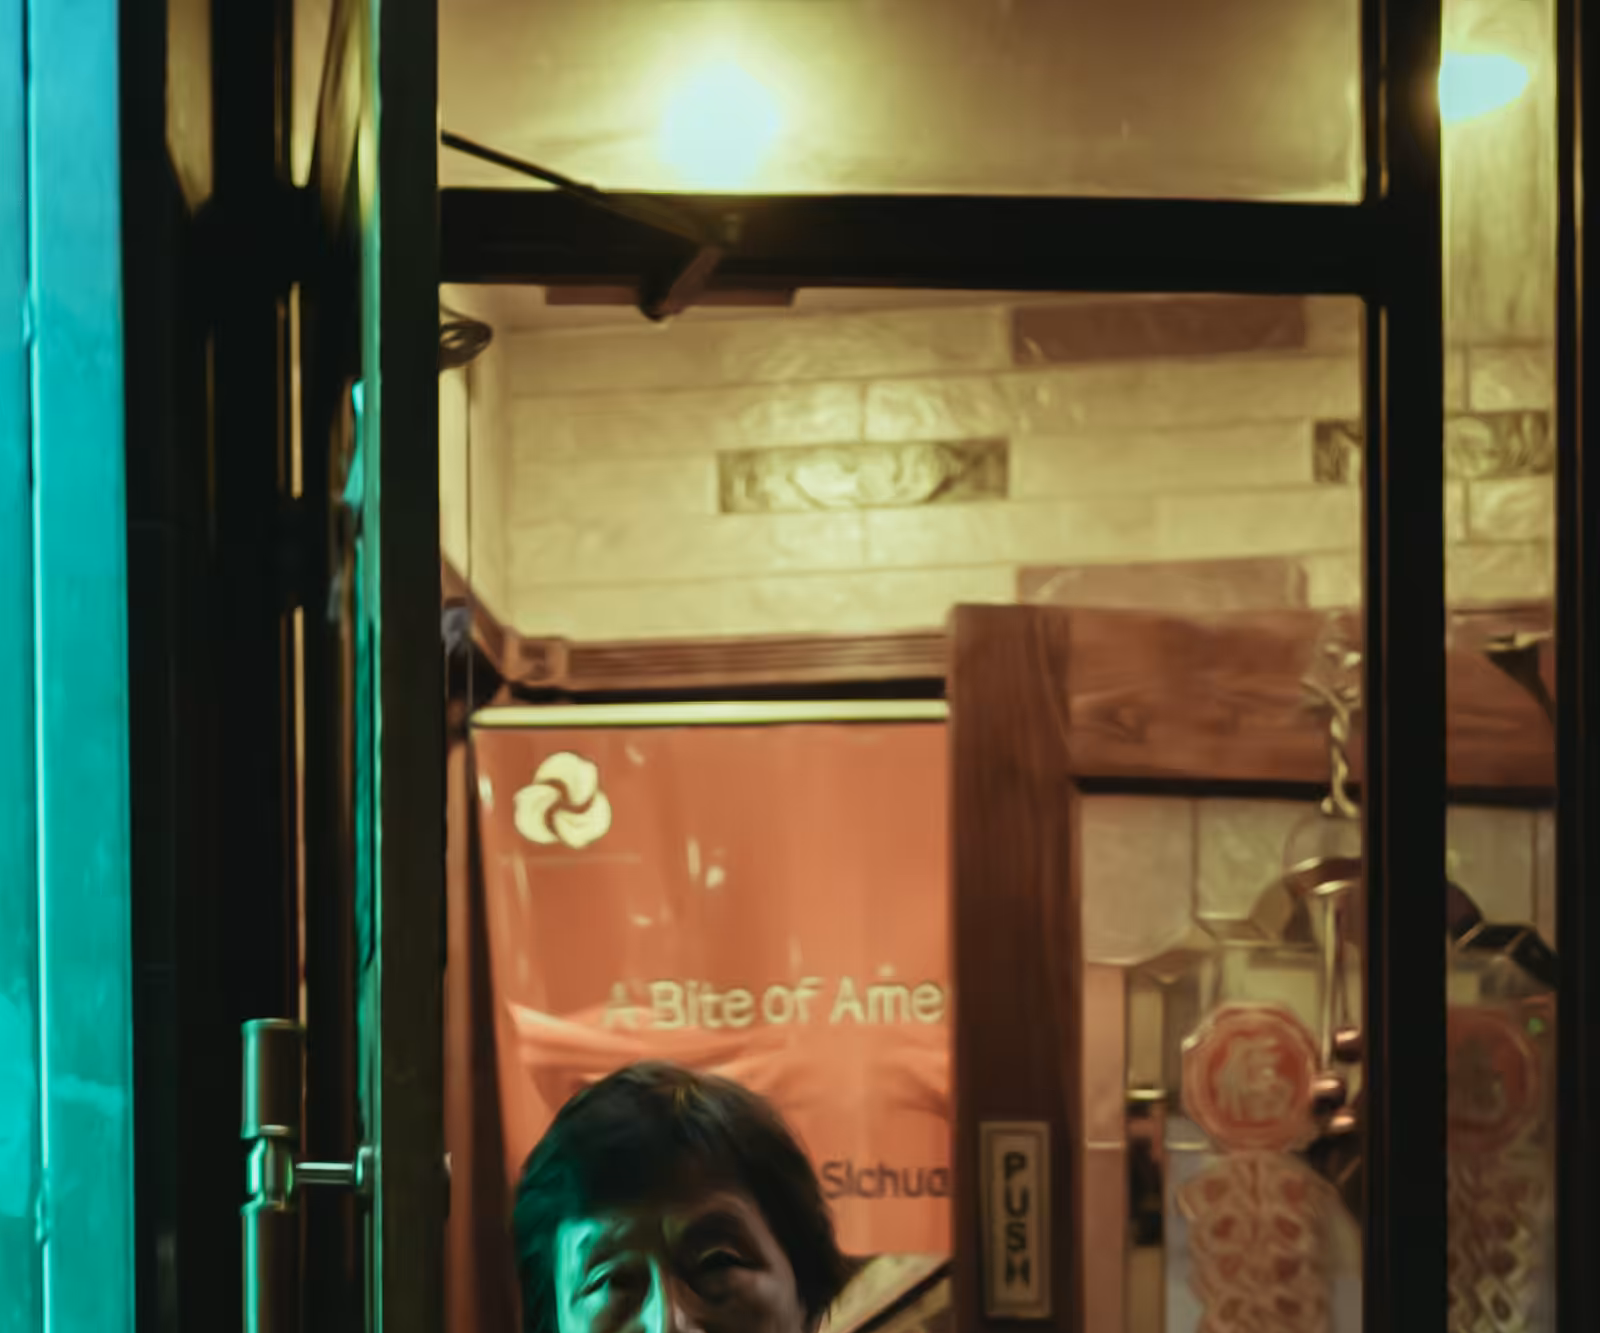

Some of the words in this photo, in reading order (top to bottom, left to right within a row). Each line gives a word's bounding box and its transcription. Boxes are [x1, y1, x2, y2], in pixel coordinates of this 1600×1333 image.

[603, 980, 638, 1030] A
[650, 977, 754, 1030] Bite
[763, 976, 822, 1026] of
[830, 975, 947, 1026] Ame
[1003, 1150, 1030, 1289] PUSH
